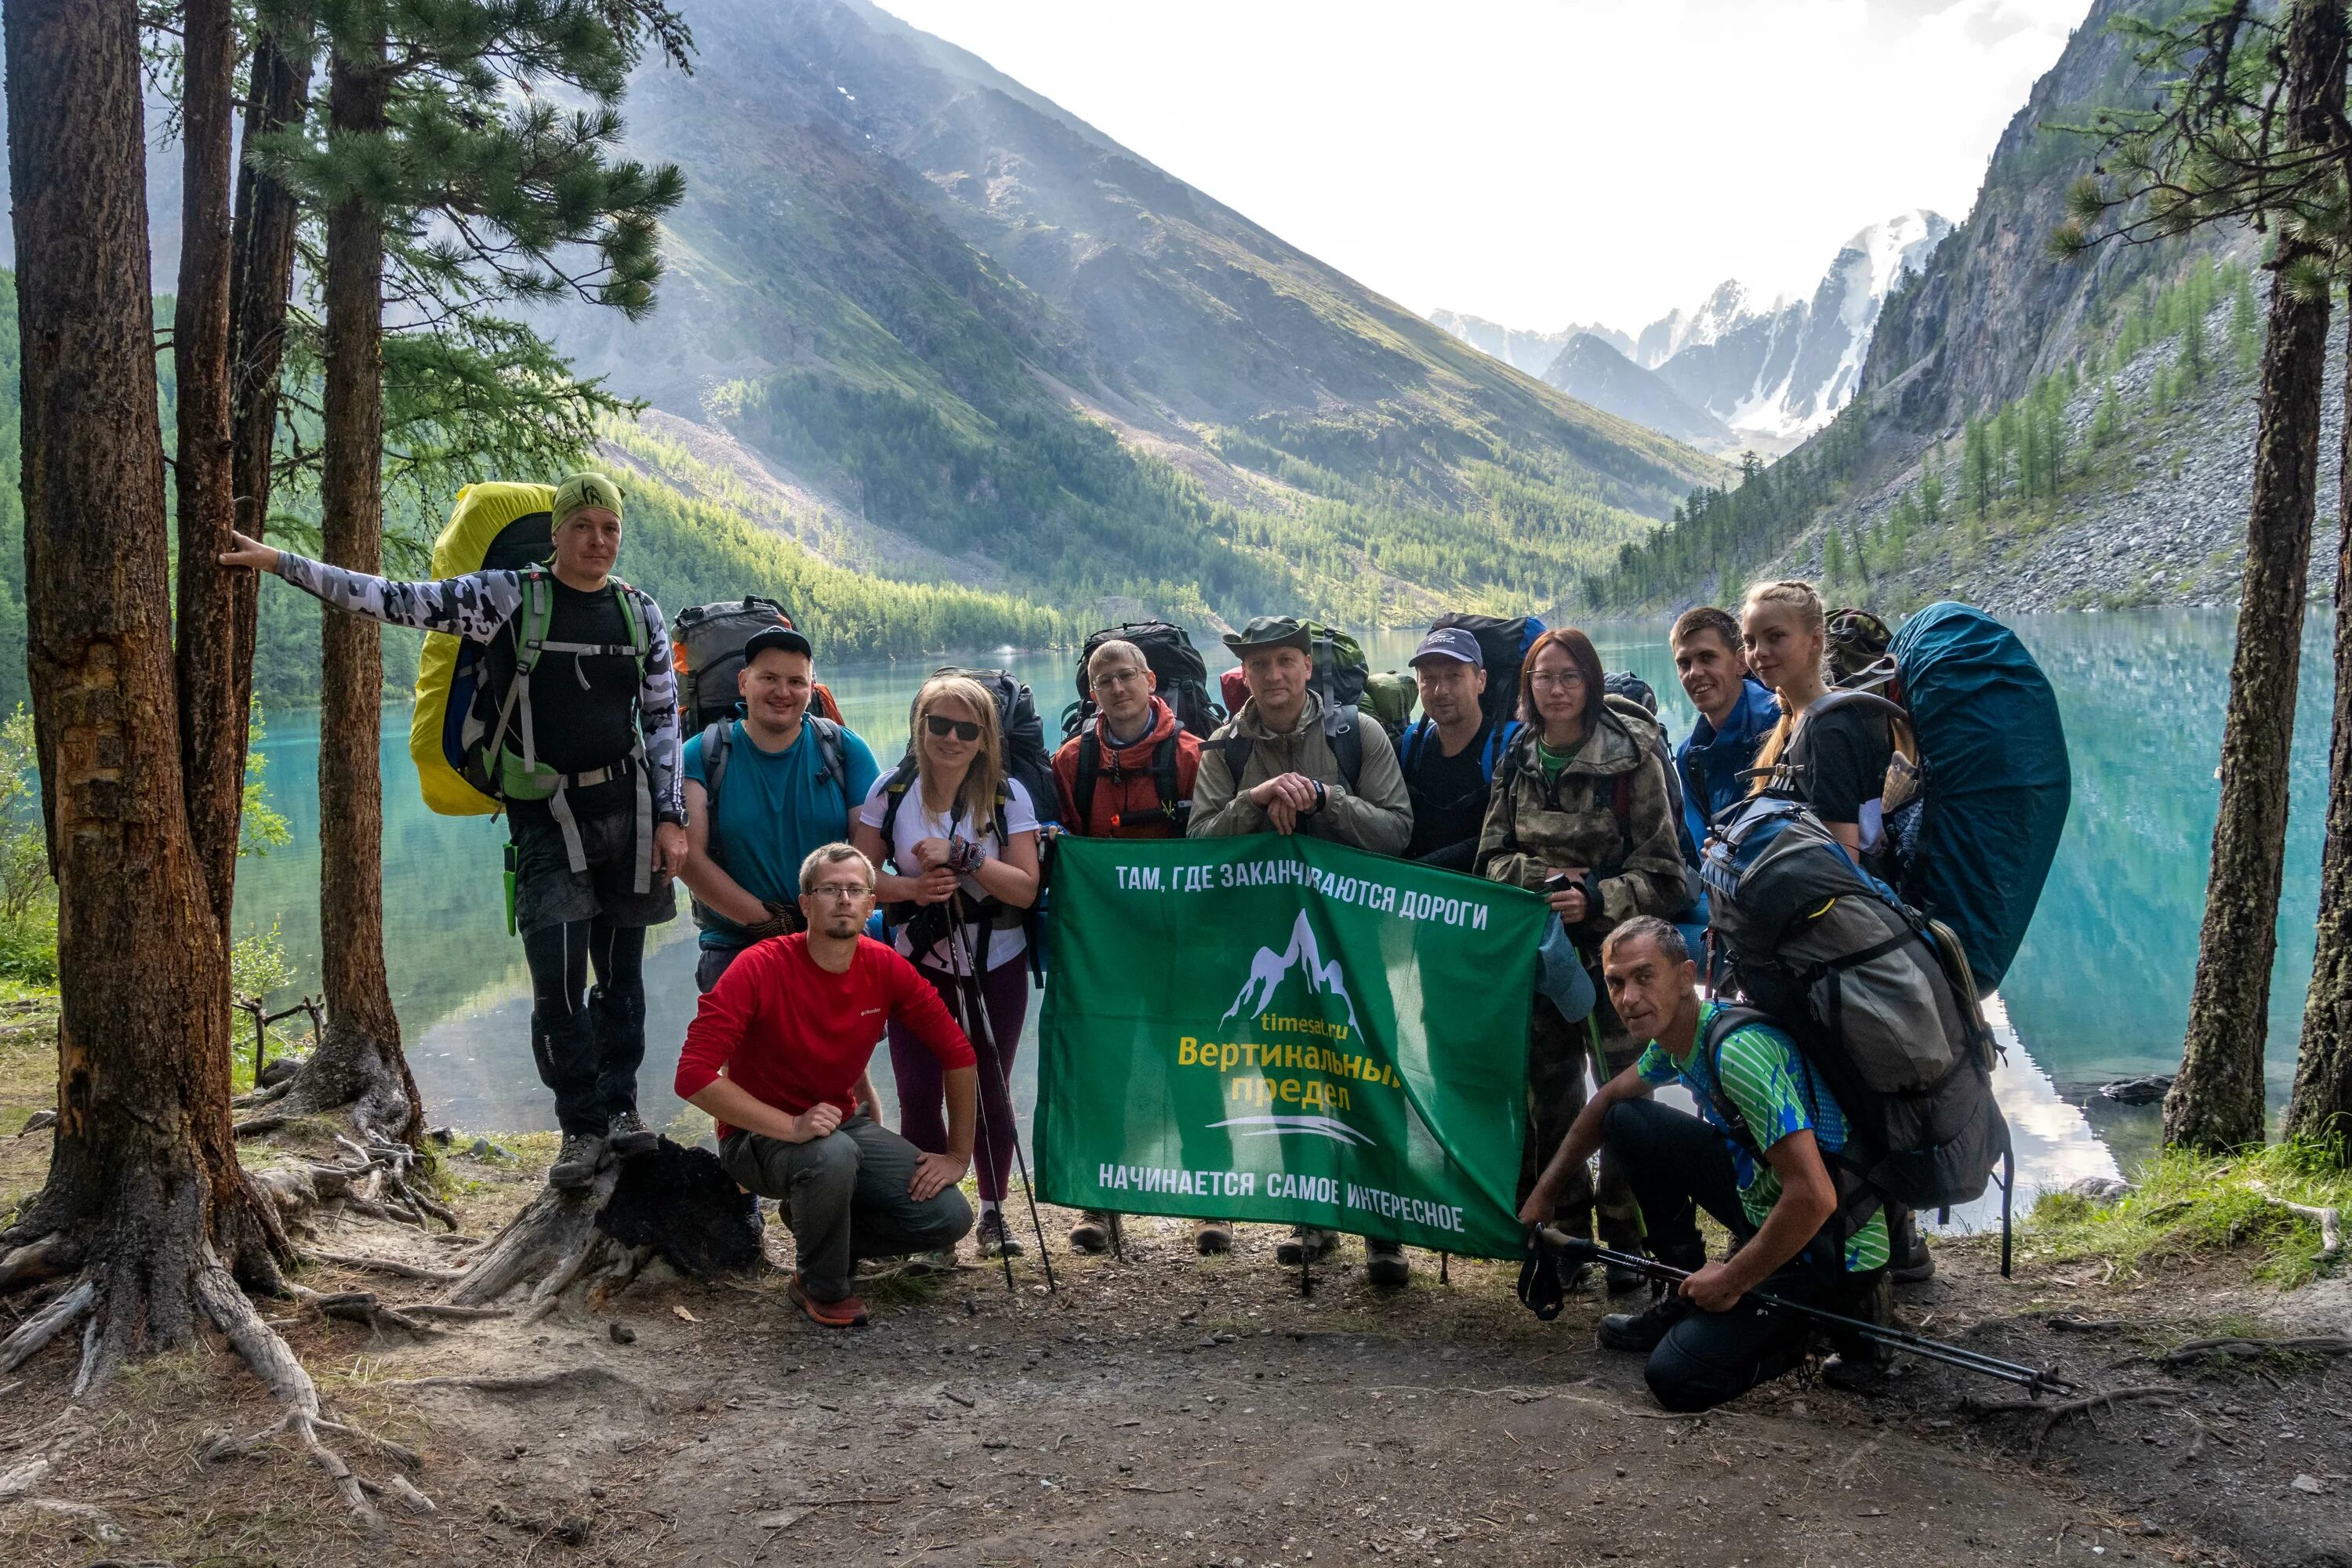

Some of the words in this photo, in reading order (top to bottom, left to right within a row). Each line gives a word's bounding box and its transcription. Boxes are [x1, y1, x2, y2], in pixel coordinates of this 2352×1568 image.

[1116, 866, 1166, 893] ТАМ,
[1172, 865, 1215, 892] ГДЕ
[1399, 890, 1489, 931] ДОРОГИ
[1261, 1013, 1348, 1040] timesat.ru
[1178, 1036, 1400, 1089] Вертикальны
[1232, 1077, 1351, 1111] предел
[1099, 1163, 1255, 1196] НАЧИНАЕТСЯ
[1267, 1173, 1340, 1205] САМОЕ
[1347, 1182, 1465, 1233] ИНТЕРЕСНОЕ
